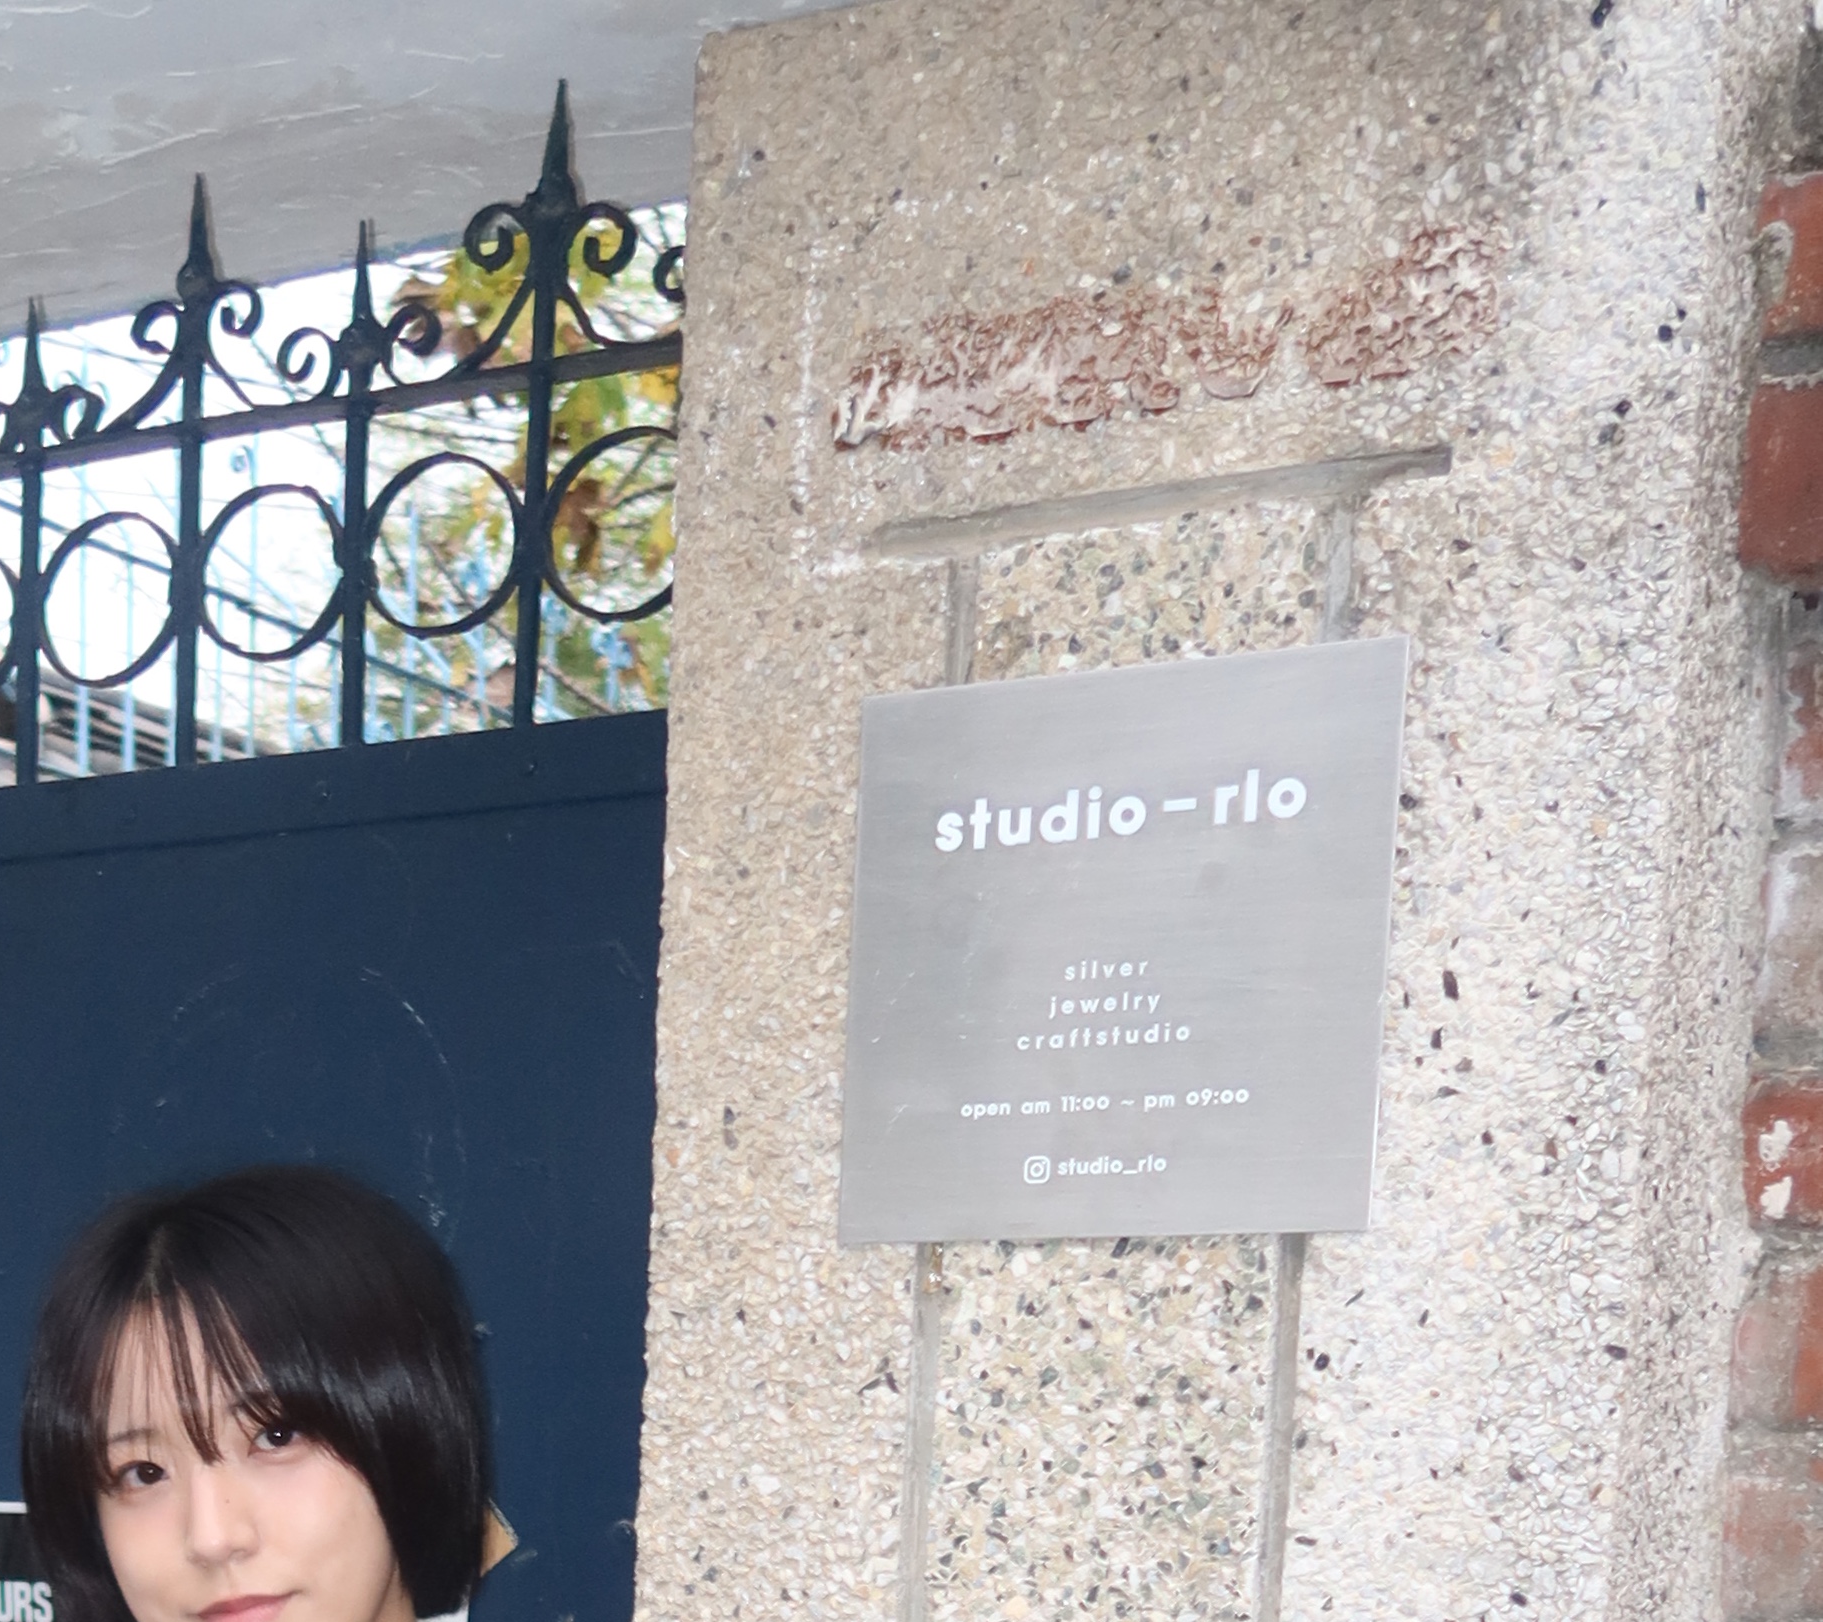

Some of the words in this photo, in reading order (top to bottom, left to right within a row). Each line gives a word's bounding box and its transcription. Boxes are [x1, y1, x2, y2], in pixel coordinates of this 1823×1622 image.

[1064, 960, 1149, 982] silver
[1048, 991, 1161, 1020] jewelry
[1016, 1022, 1191, 1051] craftstudio
[960, 1101, 1012, 1121] open
[1021, 1099, 1051, 1115] am
[1061, 1094, 1111, 1113] 11:00
[1143, 1092, 1176, 1113] pm
[1185, 1087, 1251, 1107] 09:00
[1057, 1153, 1168, 1177] studio_rlo
